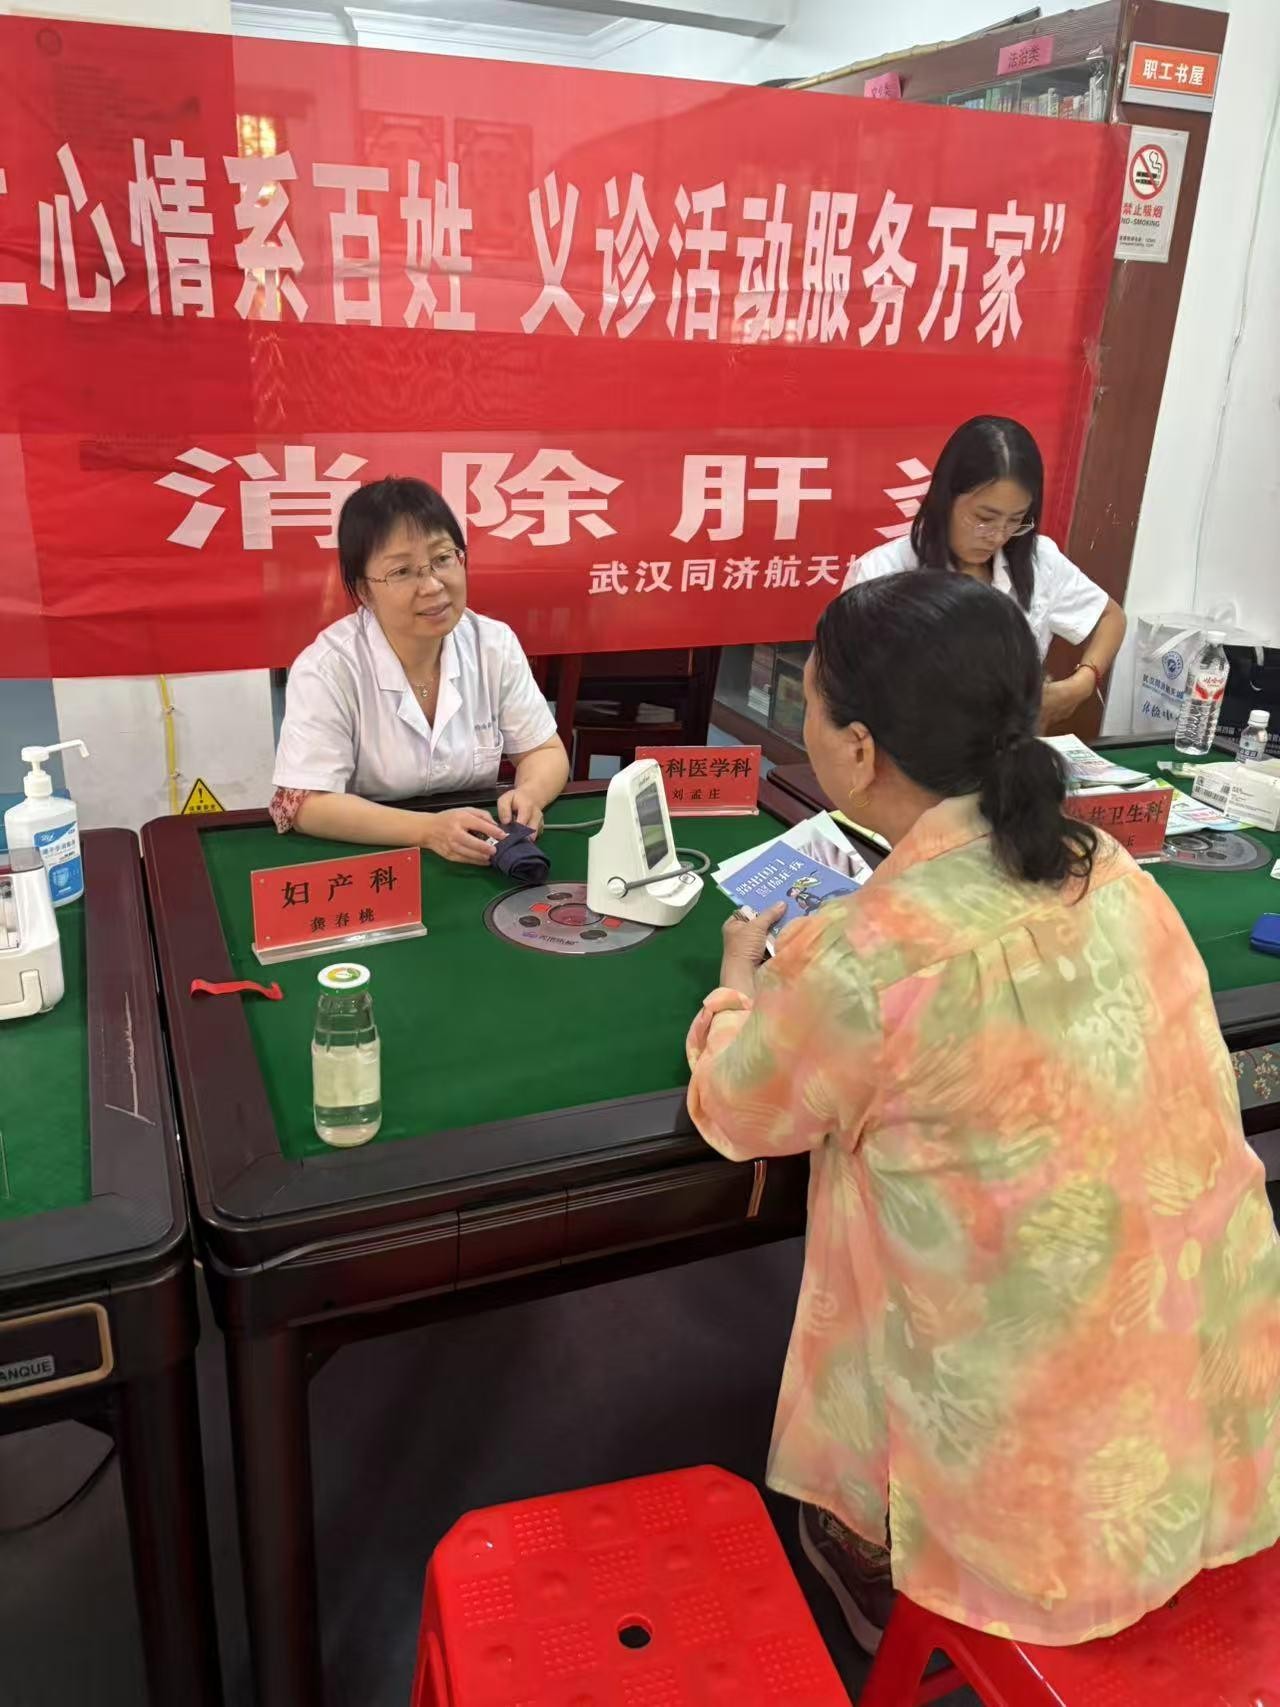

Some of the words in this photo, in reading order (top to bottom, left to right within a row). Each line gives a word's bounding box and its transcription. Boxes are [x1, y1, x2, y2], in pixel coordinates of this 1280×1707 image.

[1143, 59, 1204, 86] 职工书屋
[1122, 202, 1163, 218] 禁止吸烟
[520, 169, 1067, 348] 义诊活动服务万家”
[657, 758, 752, 779] 科医学科
[281, 866, 397, 908] 妇产科
